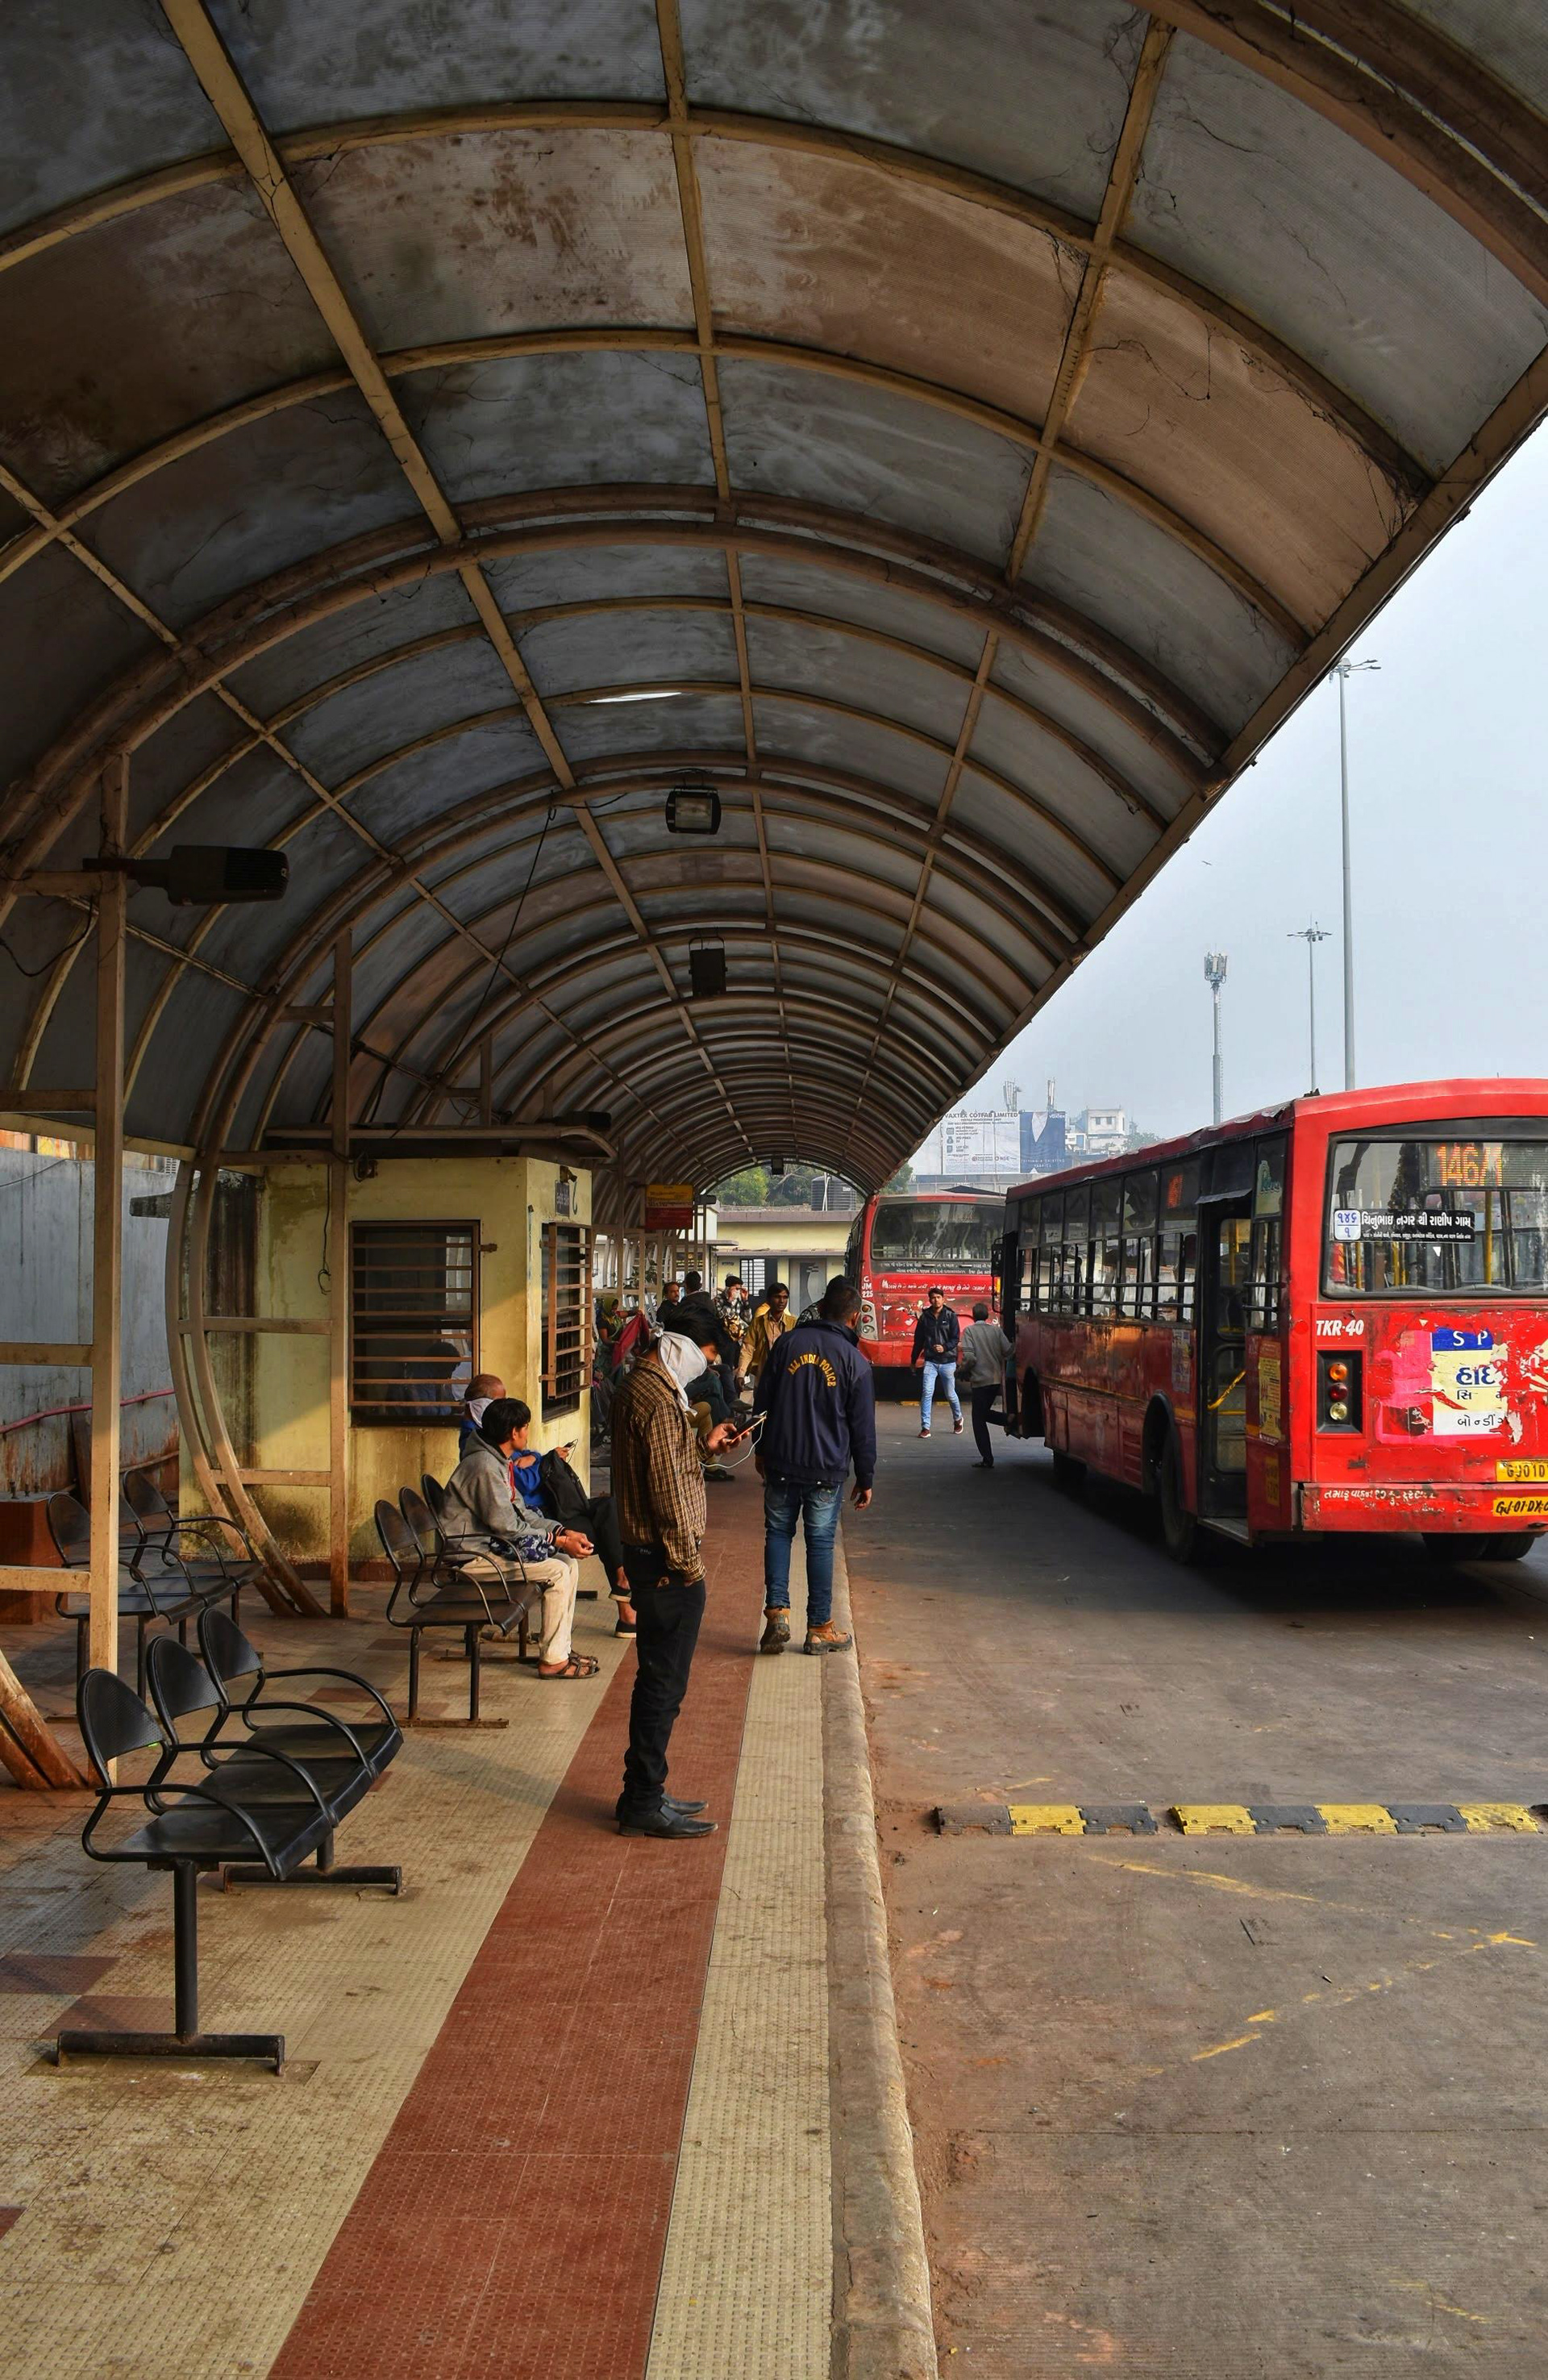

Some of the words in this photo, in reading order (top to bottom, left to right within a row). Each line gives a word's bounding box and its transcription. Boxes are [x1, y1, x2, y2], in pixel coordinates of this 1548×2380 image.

[1436, 1144, 1503, 1186] 146/1
[1396, 1215, 1416, 1226] નગર
[1418, 1211, 1428, 1226] થી
[1429, 1211, 1452, 1226] રાણીપ
[1454, 1216, 1471, 1227] ગામ
[1453, 1330, 1465, 1347] S
[787, 1359, 801, 1376] ALL
[800, 1353, 820, 1365] INDIA
[819, 1359, 837, 1387] POLICE
[1507, 1465, 1548, 1478] GJ01D
